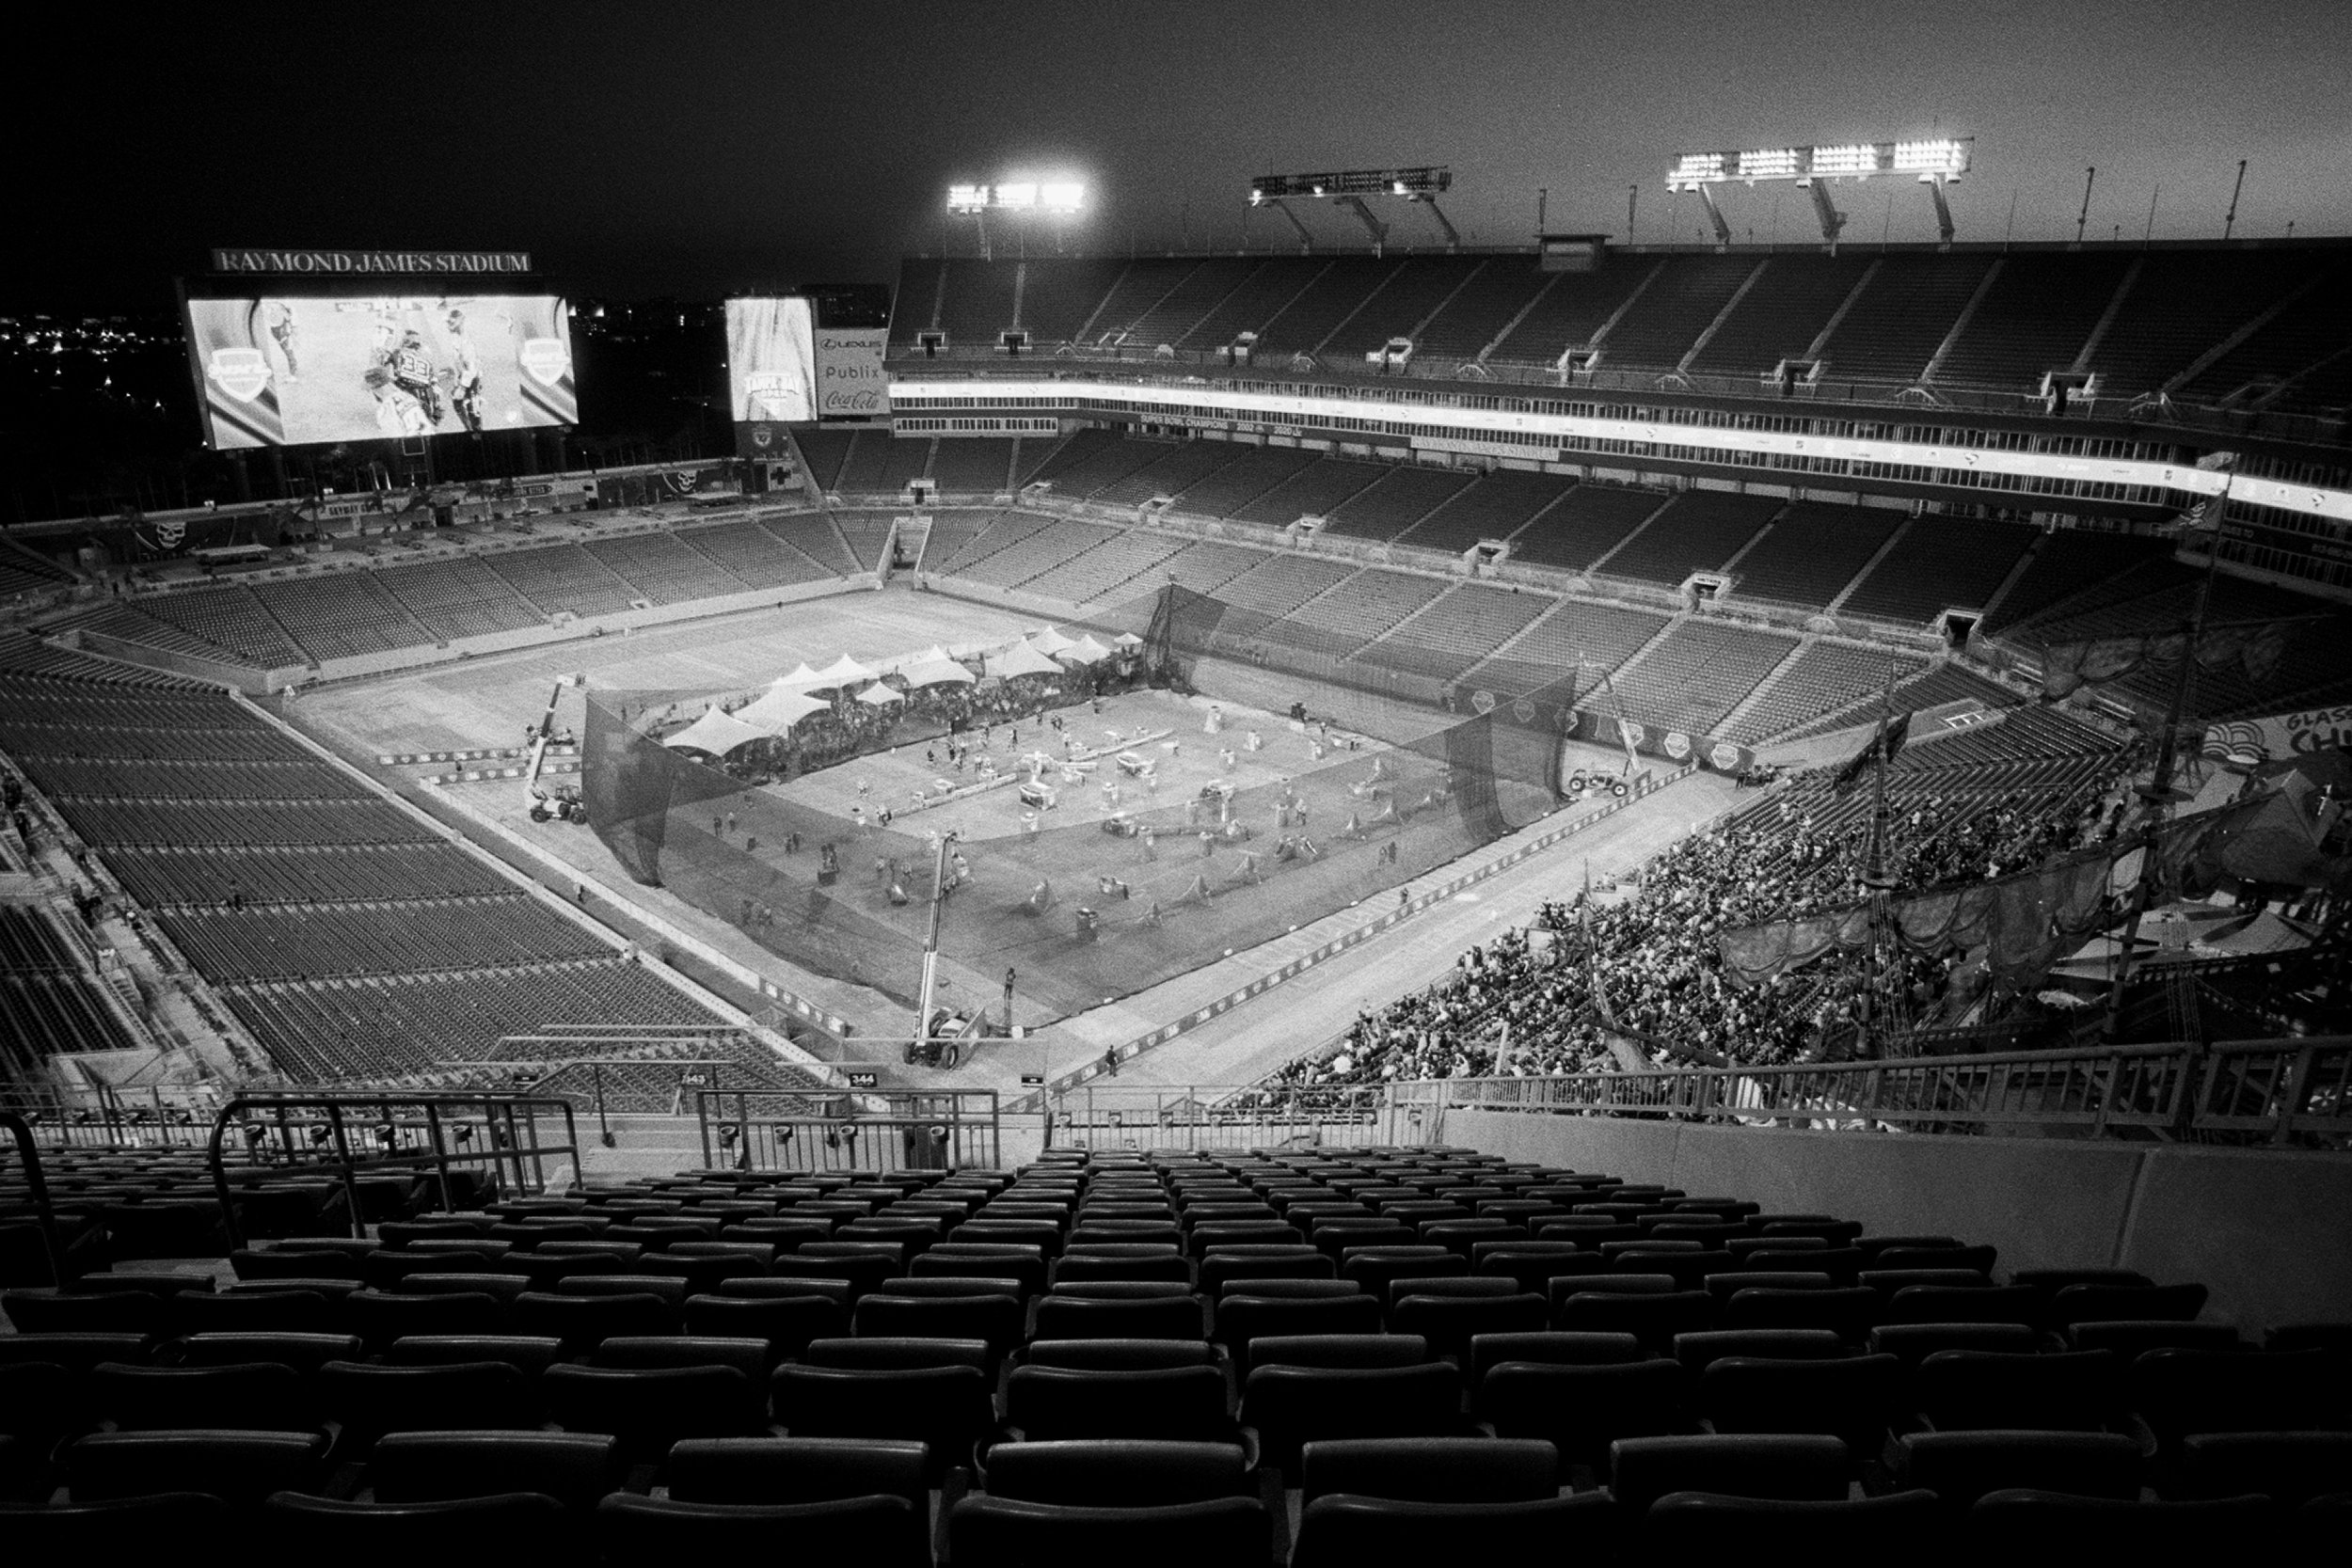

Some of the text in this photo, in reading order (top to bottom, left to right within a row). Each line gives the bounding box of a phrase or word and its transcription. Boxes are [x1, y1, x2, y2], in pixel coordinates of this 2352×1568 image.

[220, 253, 529, 273] RAYMOND JAMES STADIUM
[826, 366, 879, 379] Publix
[1141, 416, 1163, 425] SUPER
[1165, 417, 1184, 427] BOWL
[1185, 419, 1229, 431] CHAMPIONS
[1236, 422, 1254, 432] 2002
[1274, 426, 1292, 436] 2020
[851, 1074, 875, 1085] 344
